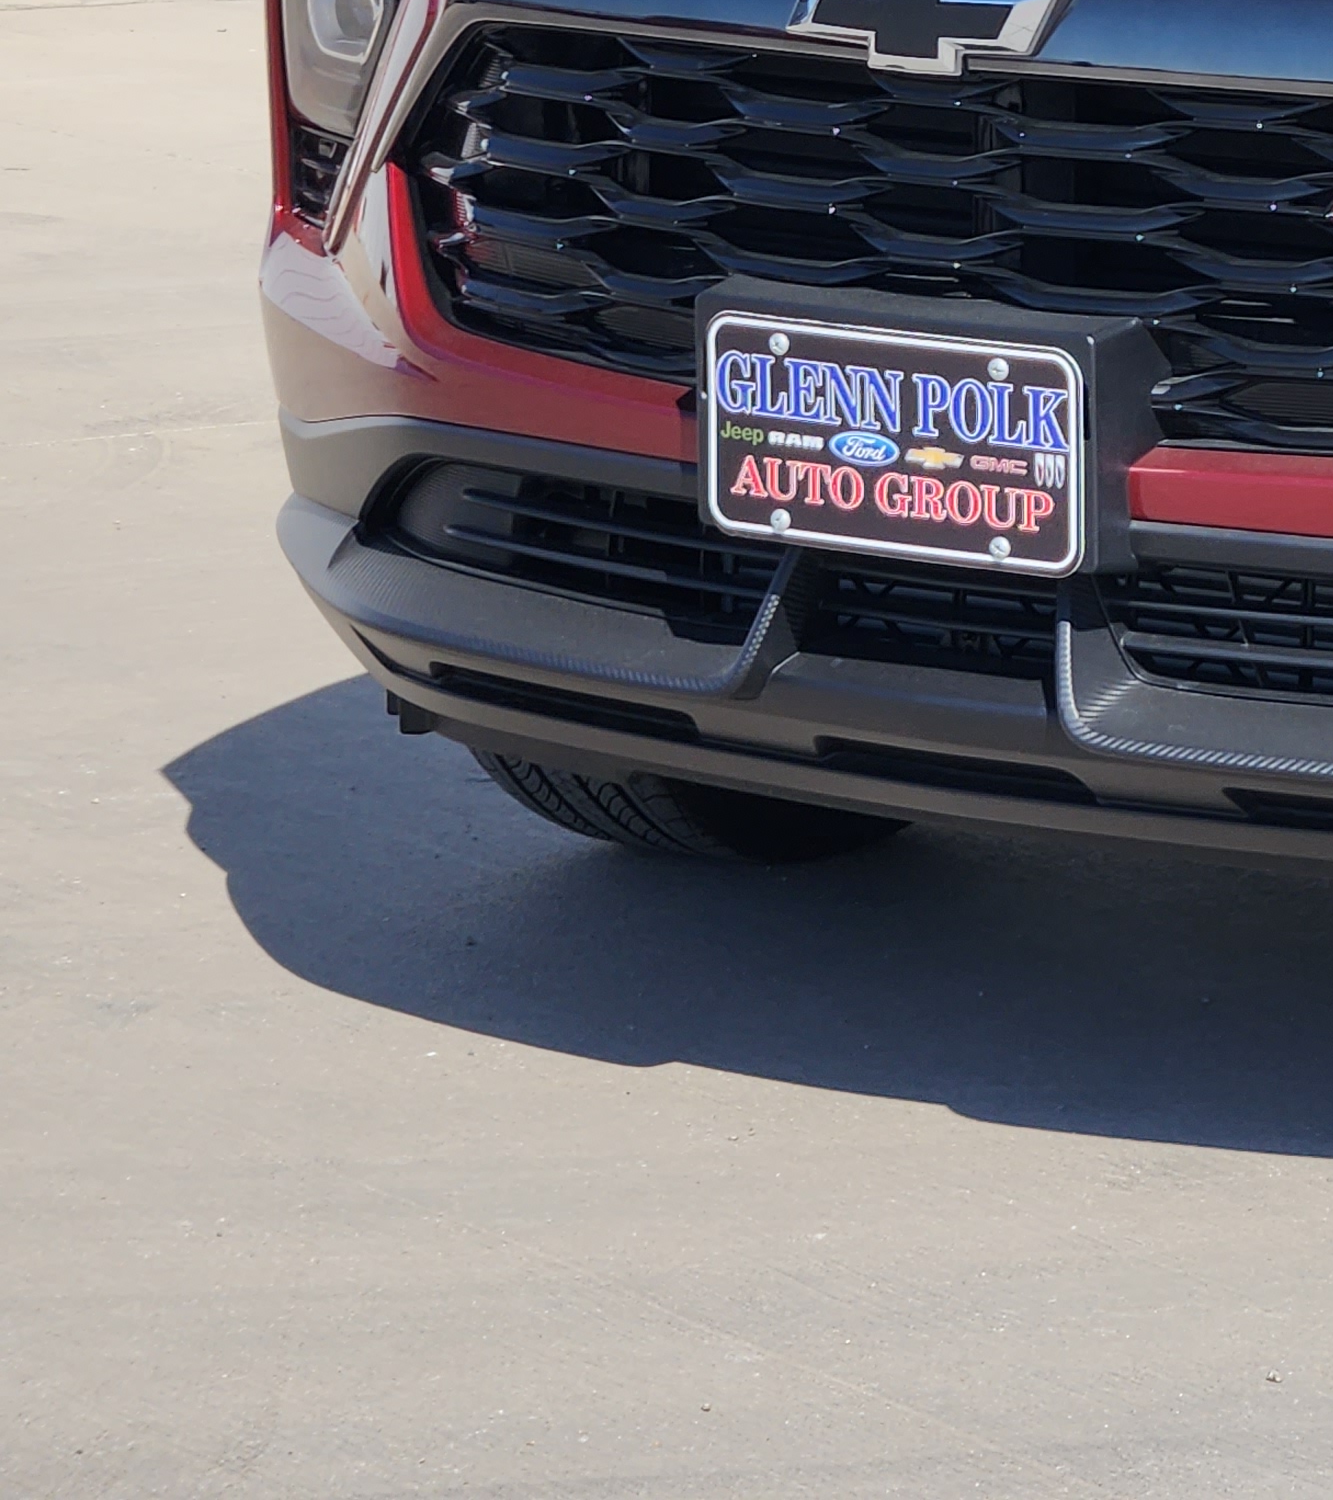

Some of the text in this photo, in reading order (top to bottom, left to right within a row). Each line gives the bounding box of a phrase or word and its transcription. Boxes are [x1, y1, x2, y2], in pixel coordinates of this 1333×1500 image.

[715, 348, 1070, 451] GLENN POLK
[720, 421, 1029, 476] Jeep RAM Ford GMC
[730, 454, 1055, 533] AUTO GROUP
